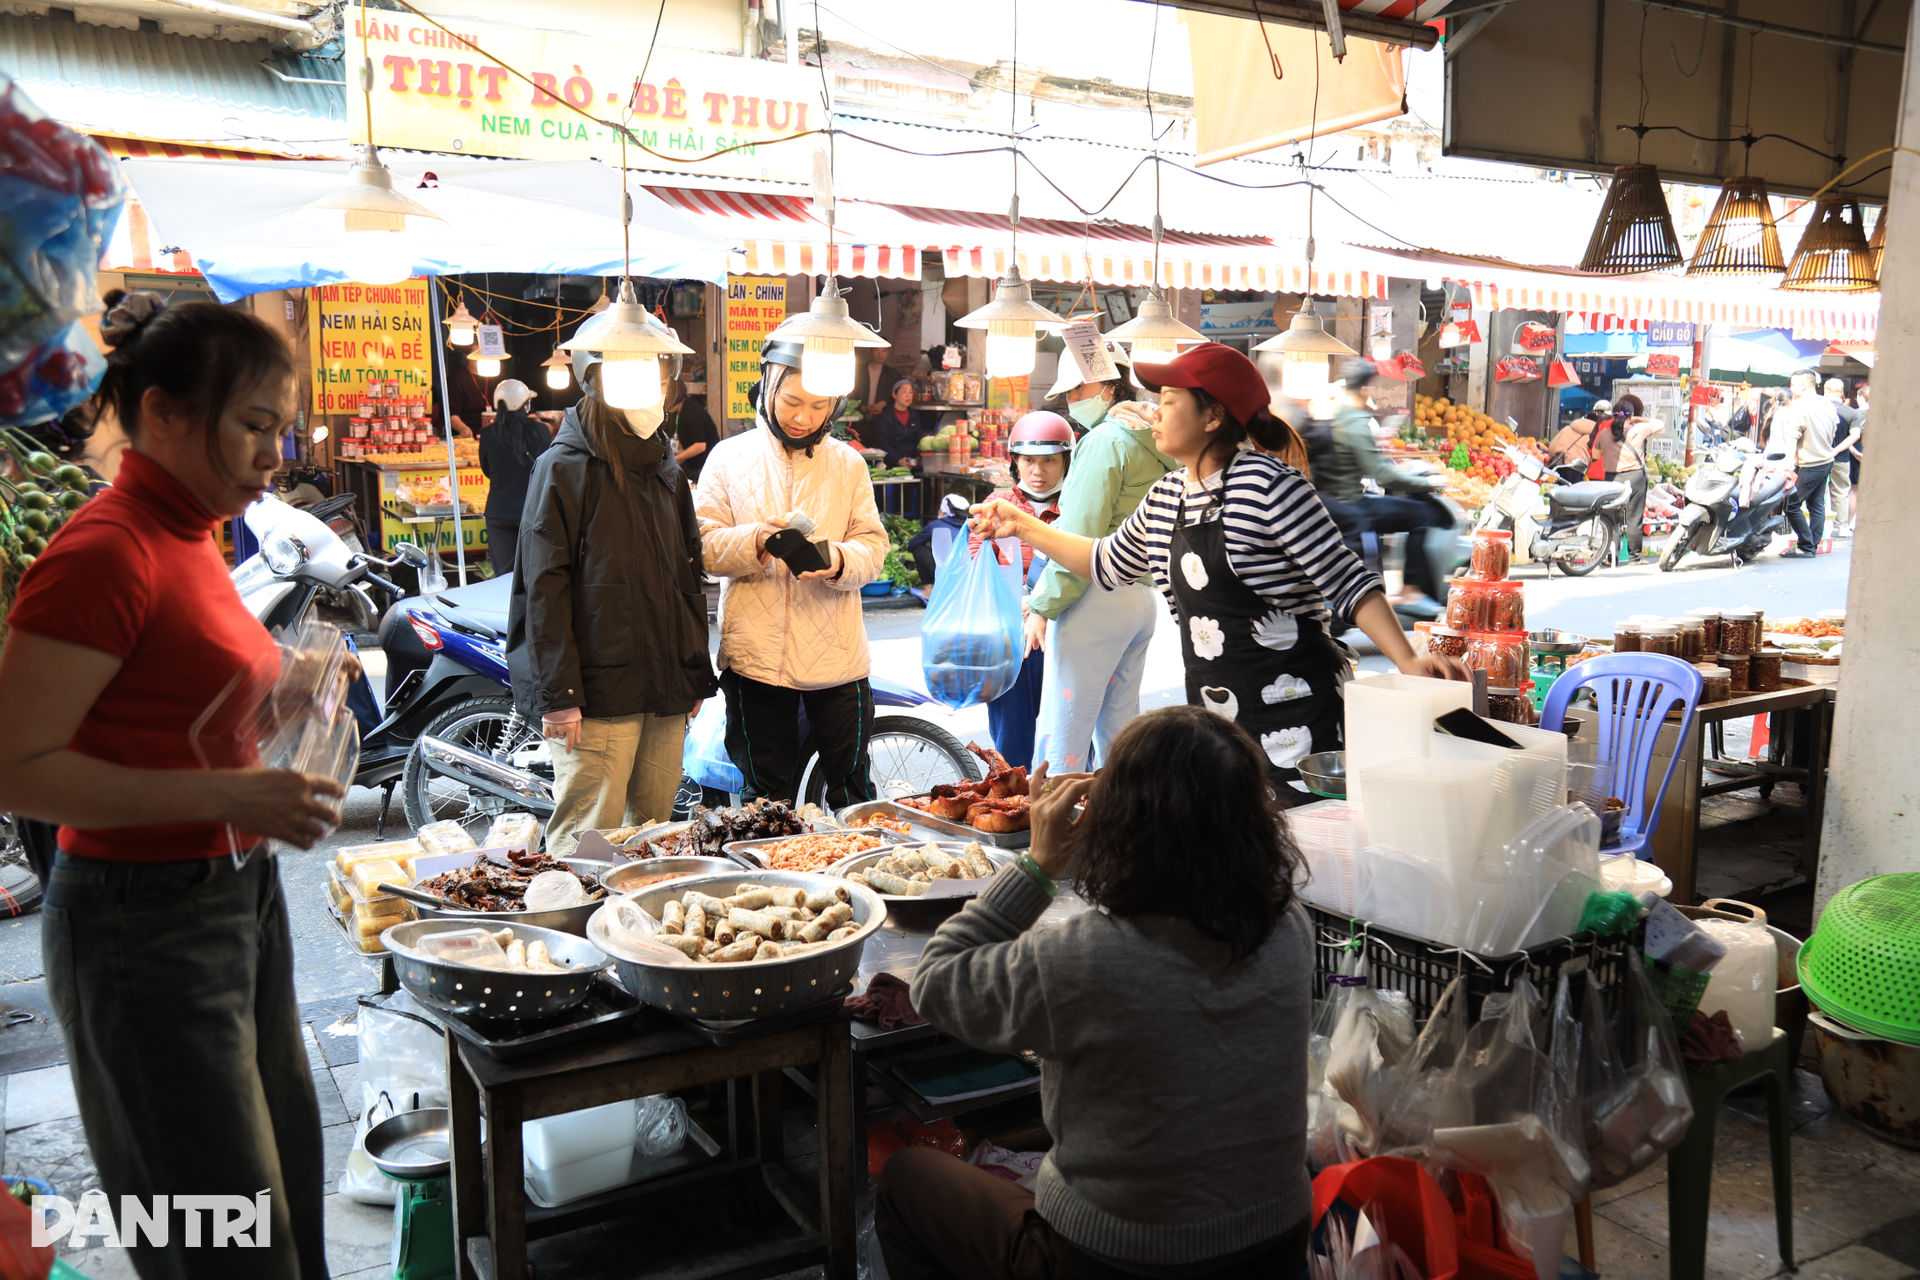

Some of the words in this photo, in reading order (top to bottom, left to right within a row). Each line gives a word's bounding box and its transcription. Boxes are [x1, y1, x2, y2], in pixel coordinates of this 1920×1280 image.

[355, 18, 400, 42] LÂN
[383, 54, 508, 109] THỊT
[530, 64, 593, 110] BÒ
[633, 78, 688, 120] BÊ
[703, 90, 809, 133] THUI
[481, 113, 531, 137] NEM
[540, 119, 589, 142] CUA
[612, 126, 658, 149] NEM
[668, 126, 705, 152] HẢI
[715, 131, 757, 158] SẢN
[342, 283, 363, 303] TÉP
[404, 289, 426, 309] THỊT
[728, 281, 747, 301] LÂN
[755, 281, 784, 301] CHỈNH
[322, 314, 356, 330] NEM
[362, 310, 387, 331] HẢI
[392, 311, 422, 332] SẢN
[1652, 324, 1674, 342] CẦU
[1676, 324, 1691, 342] GỖ
[319, 340, 356, 359] NEM
[362, 341, 397, 360] CUA
[729, 339, 750, 352] NEM
[317, 368, 351, 384] NEM
[355, 365, 389, 384] TÔM
[394, 369, 427, 387] THỊT
[730, 360, 748, 373] NEM
[318, 389, 335, 410] BÒ
